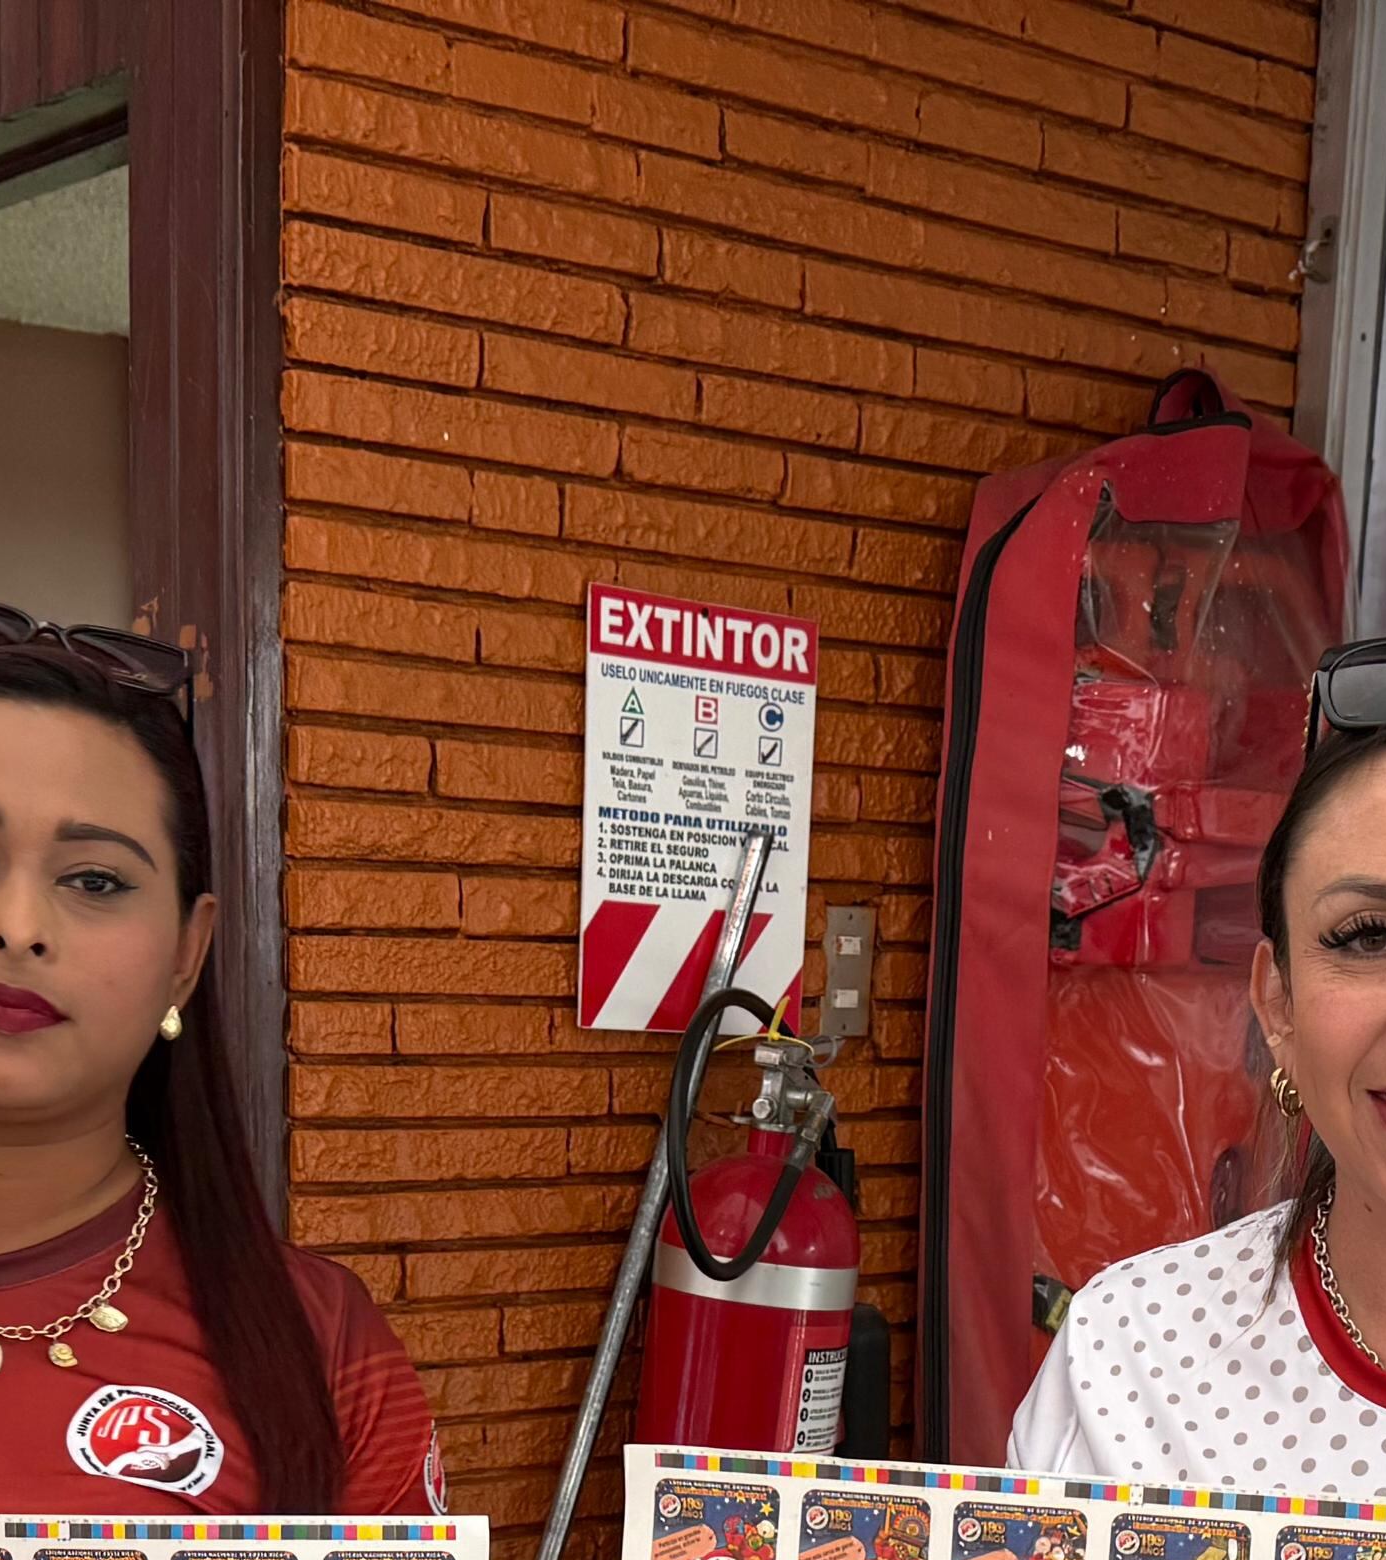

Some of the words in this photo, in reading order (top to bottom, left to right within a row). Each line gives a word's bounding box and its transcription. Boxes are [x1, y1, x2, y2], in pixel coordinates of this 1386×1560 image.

[599, 596, 809, 674] EXTINTOR
[601, 662, 637, 681] USELO
[639, 669, 707, 692] UNICAMENTE
[710, 679, 724, 694] EN
[726, 682, 769, 700] FUEGOS
[771, 687, 805, 705] CLASE
[637, 768, 655, 780] Papel
[598, 806, 660, 824] METODO
[664, 813, 703, 828] PARA
[599, 822, 608, 834] 1.
[610, 824, 667, 843] SOSTENGA
[670, 831, 684, 842] EN
[687, 832, 736, 846] POSICION
[597, 838, 607, 849] 2.
[610, 839, 648, 851] RETIRE
[651, 843, 663, 854] EL
[666, 844, 709, 858] SEGURO
[597, 852, 606, 864] 3.
[609, 853, 650, 867] OPRIMA
[653, 858, 666, 868] LA
[669, 859, 717, 873] PALANCA
[597, 867, 606, 878] 4.
[609, 868, 644, 881] DIRIJA
[646, 872, 659, 882] LA
[662, 873, 718, 888] DESCARGA
[766, 882, 779, 893] LA
[608, 882, 636, 895] BASE
[638, 885, 653, 896] DE
[655, 886, 669, 898] LA
[671, 888, 707, 902] LLAMA
[76, 1407, 100, 1437] JUNTA
[98, 1392, 117, 1408] DE
[96, 1405, 171, 1446] JPS
